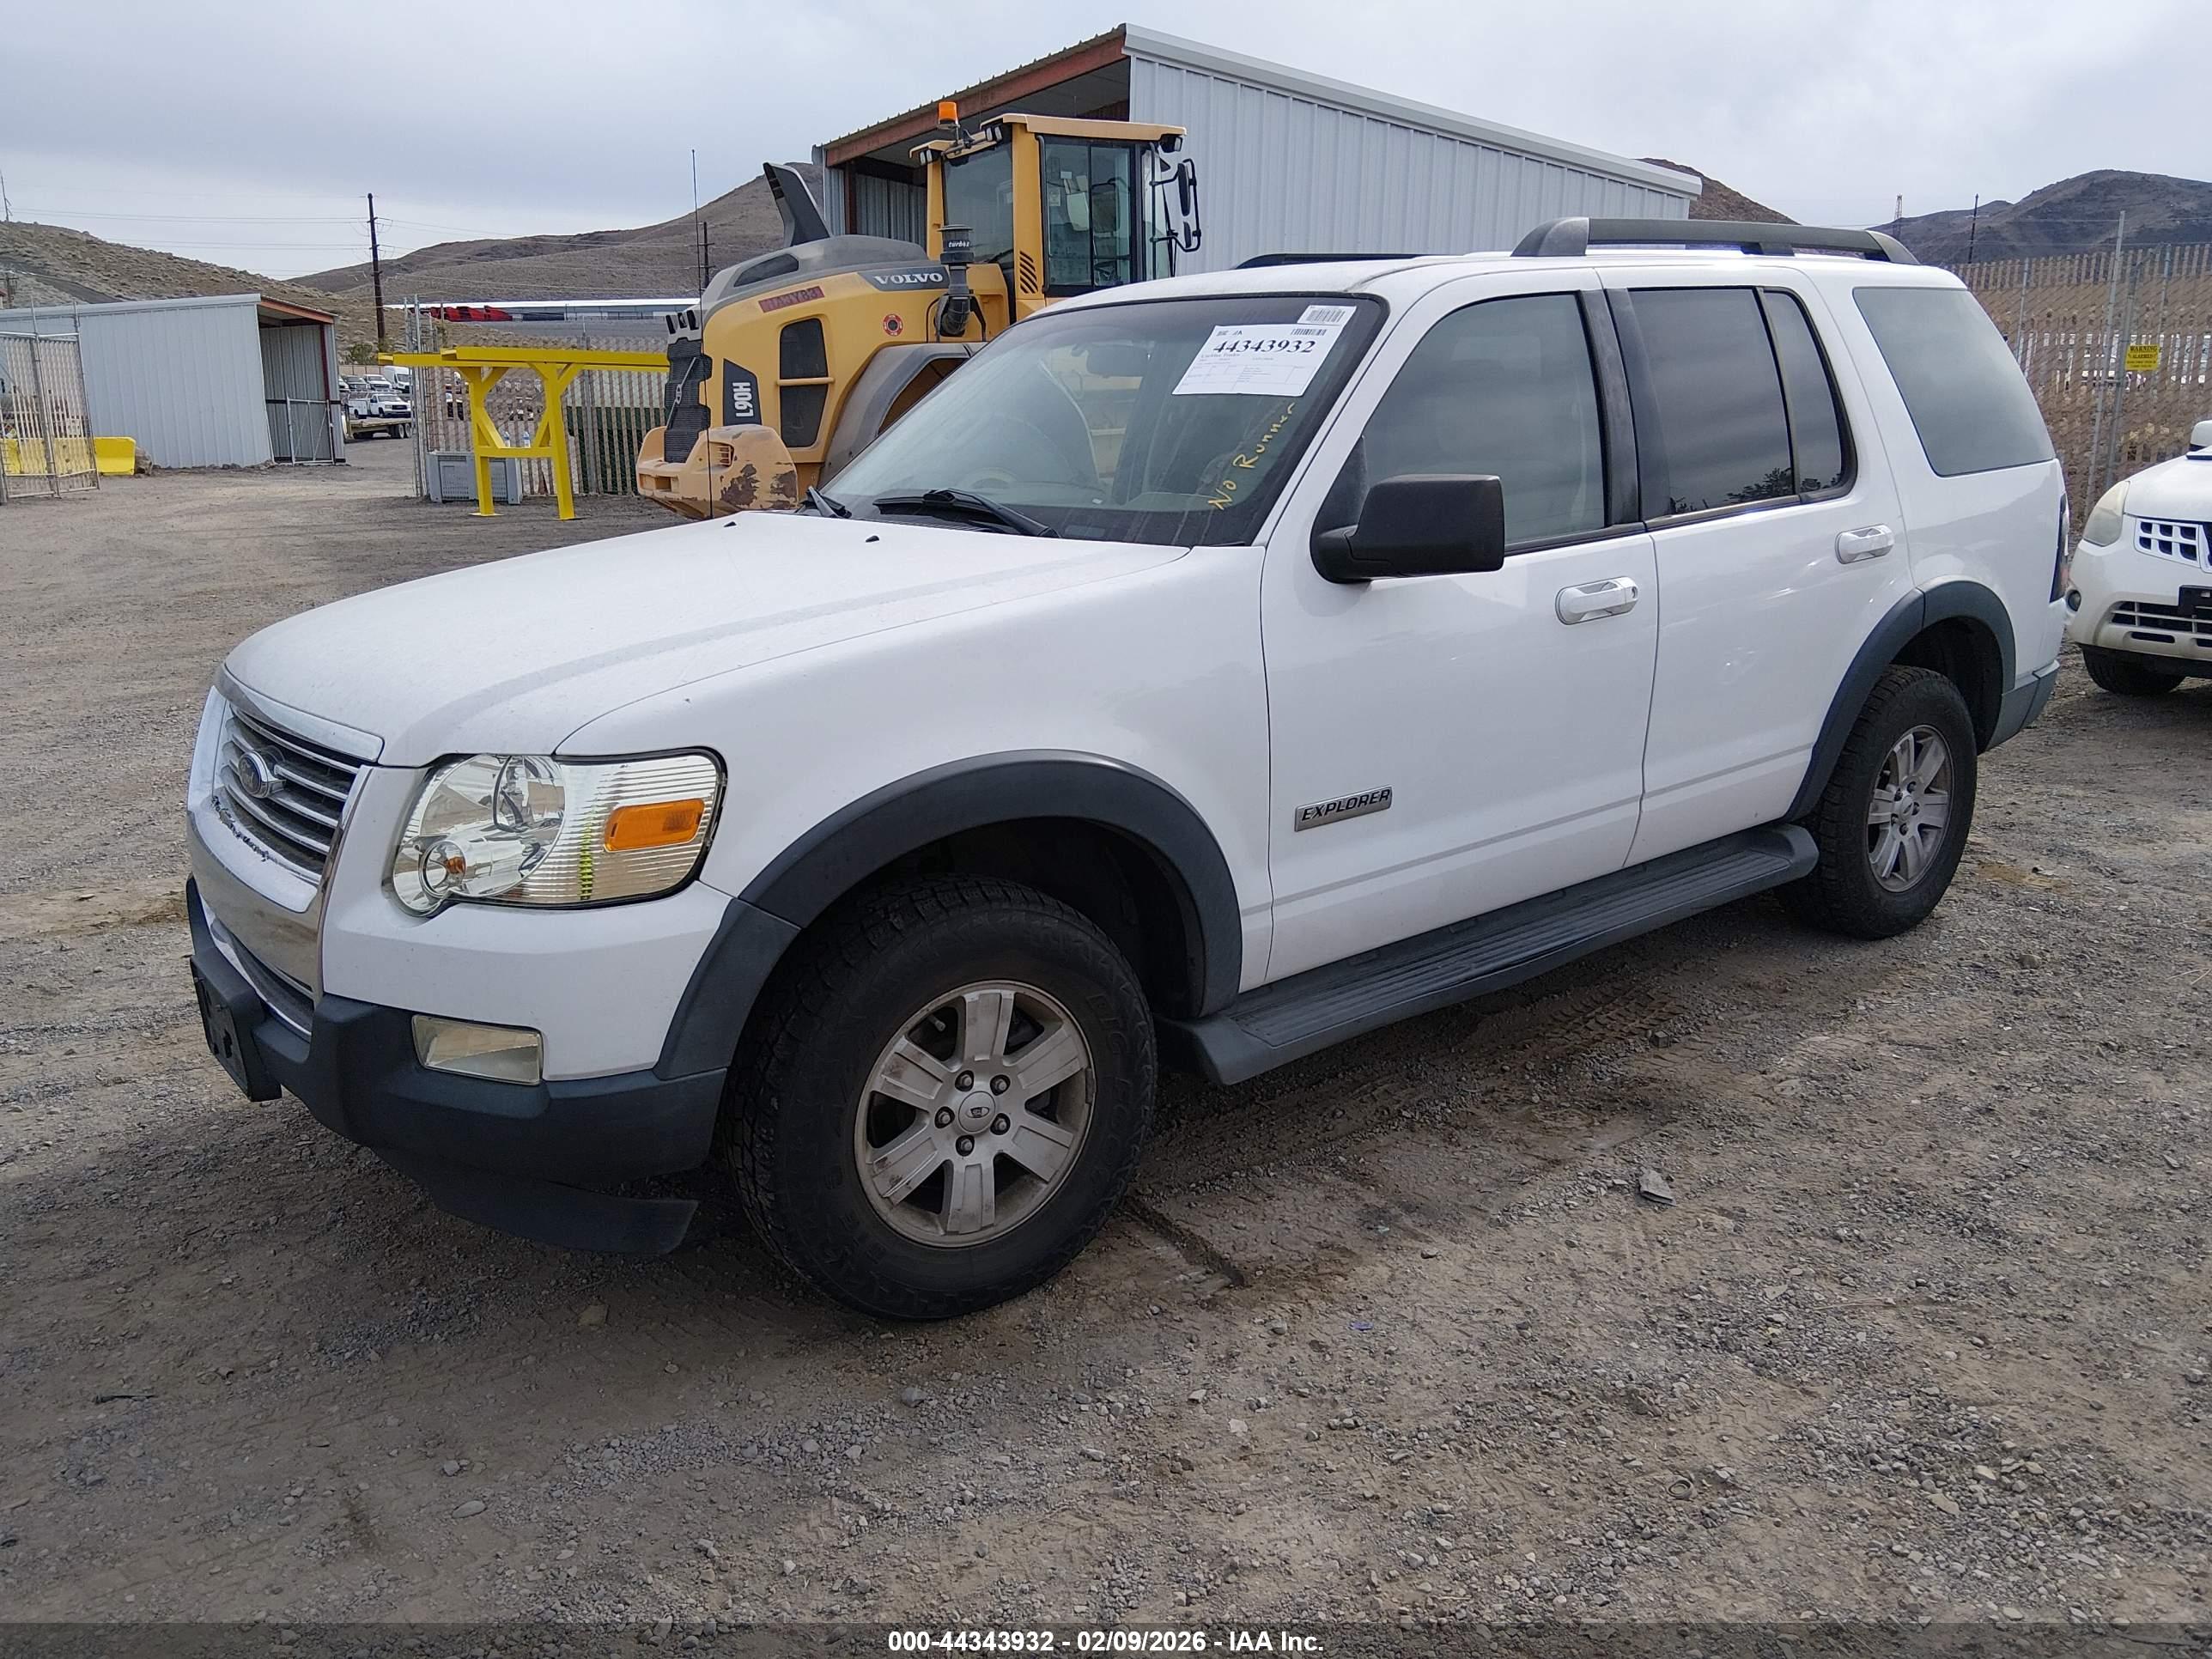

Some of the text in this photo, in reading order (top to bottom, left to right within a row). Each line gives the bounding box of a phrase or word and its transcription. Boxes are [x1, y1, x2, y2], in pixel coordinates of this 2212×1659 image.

[874, 272, 944, 285] VOLVO
[1212, 339, 1316, 353] 44343932
[732, 382, 754, 417] L90H
[1301, 788, 1390, 822] EXPLORER
